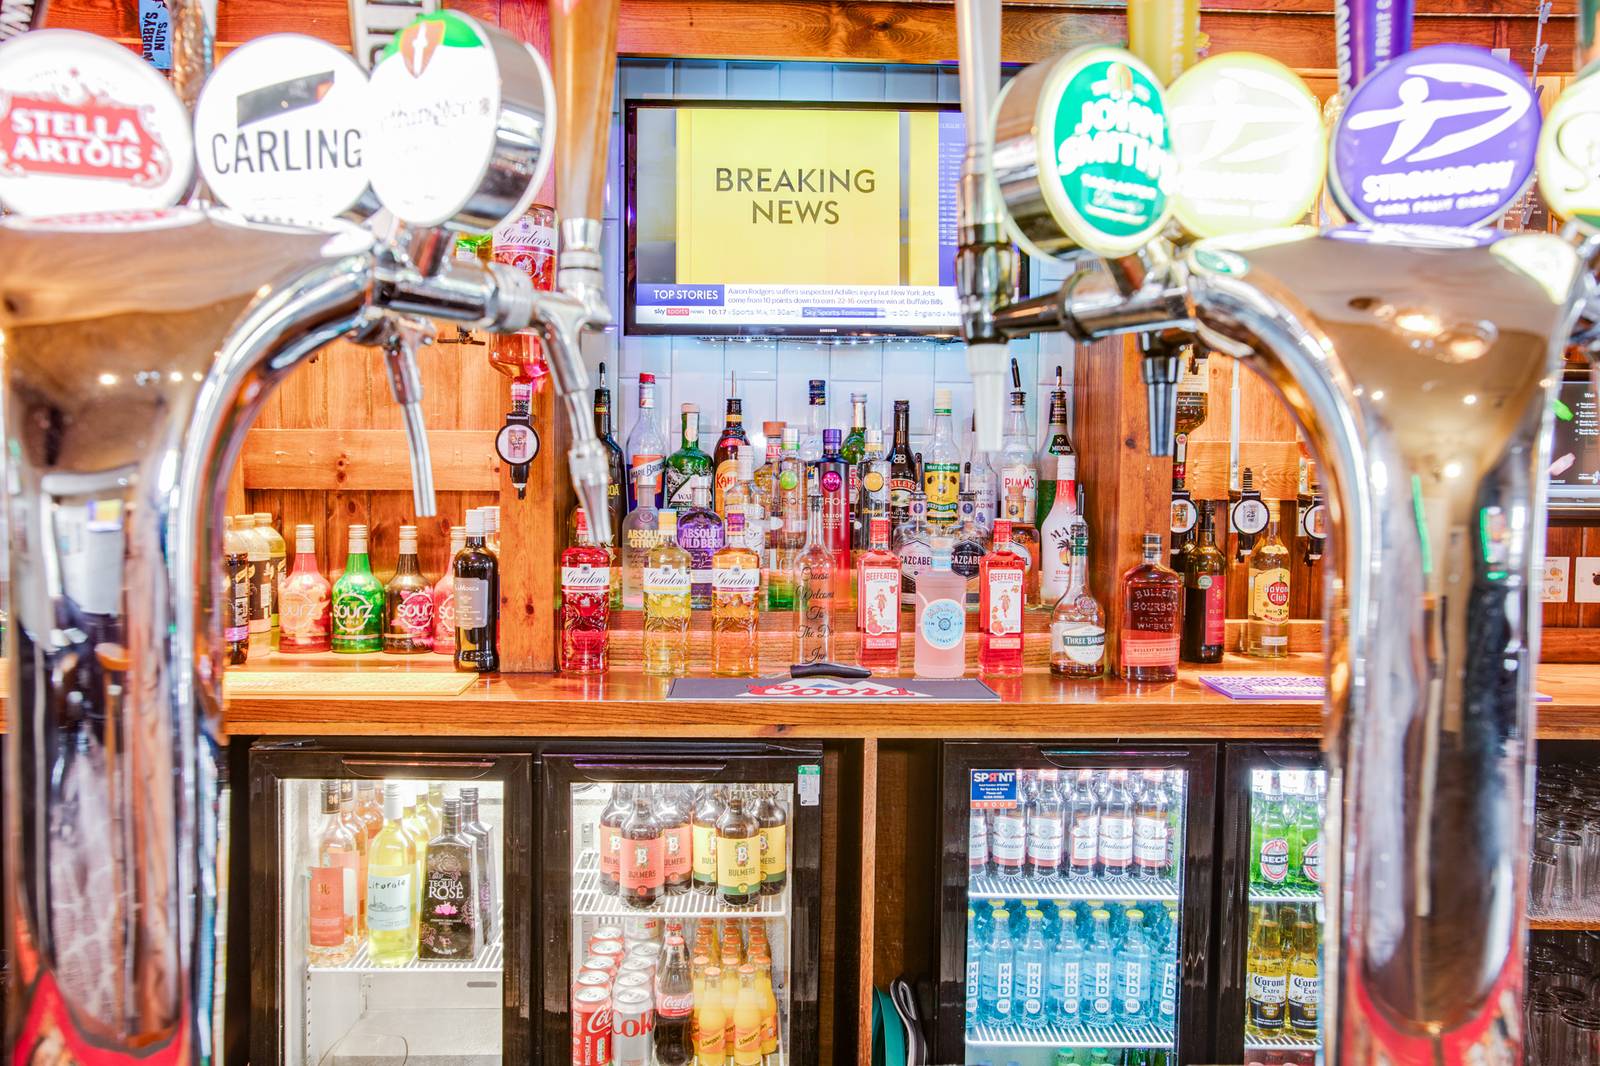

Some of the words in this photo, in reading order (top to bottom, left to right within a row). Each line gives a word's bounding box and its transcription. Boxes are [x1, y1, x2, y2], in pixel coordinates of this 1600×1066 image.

[154, 22, 168, 51] NUTS
[11, 108, 141, 144] STELLA
[12, 136, 143, 169] ARTOIS
[211, 128, 363, 176] CARLING
[716, 168, 876, 194] BREAKING
[752, 200, 839, 225] NEWS
[654, 289, 675, 300] TOP
[676, 289, 718, 300] STORIES
[654, 308, 665, 316] sky
[1004, 475, 1035, 489] PIMM'S
[627, 529, 658, 539] ABSOLU
[683, 528, 720, 539] ABSOLUT
[630, 538, 656, 549] CITRO
[565, 569, 607, 585] Gordon's
[647, 569, 688, 586] Gordon's
[716, 570, 756, 586] Gordon's
[865, 571, 898, 581] BEEFEATER
[989, 572, 1021, 582] BEEFEATER
[1270, 593, 1287, 602] Club
[1065, 636, 1085, 645] THREE
[746, 684, 915, 696] Coors
[629, 870, 657, 879] BULMERS
[728, 867, 756, 877] BULMERS
[428, 879, 463, 889] TEQUILA
[428, 887, 464, 900] ROSE
[1263, 986, 1280, 994] Extra
[612, 1009, 653, 1037] Cok
